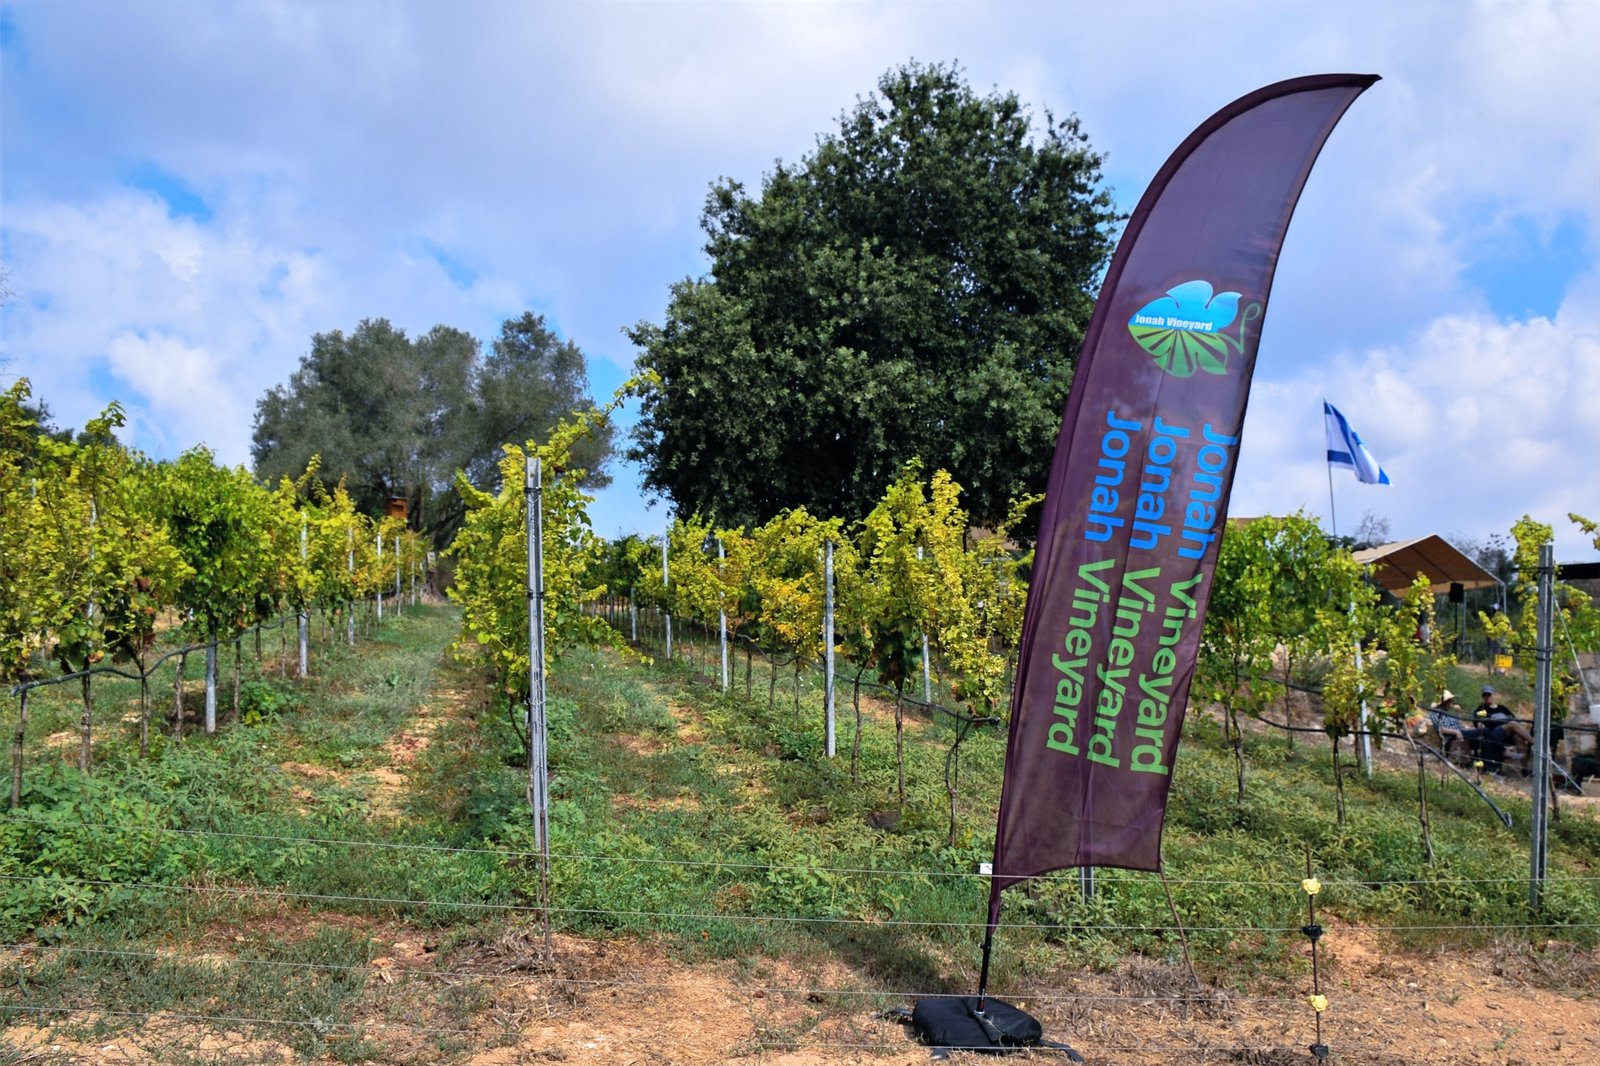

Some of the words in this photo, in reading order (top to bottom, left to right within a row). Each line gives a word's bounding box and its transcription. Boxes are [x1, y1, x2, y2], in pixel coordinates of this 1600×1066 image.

[1135, 314, 1165, 326] Jonah
[1166, 316, 1213, 331] Vineyard
[1084, 409, 1143, 542] Jonah
[1129, 415, 1191, 551] Jonah
[1177, 422, 1238, 560] Jonah
[1046, 558, 1116, 756] Vineyard
[1086, 566, 1161, 768] Vineyard
[1129, 572, 1204, 775] Vineyard
